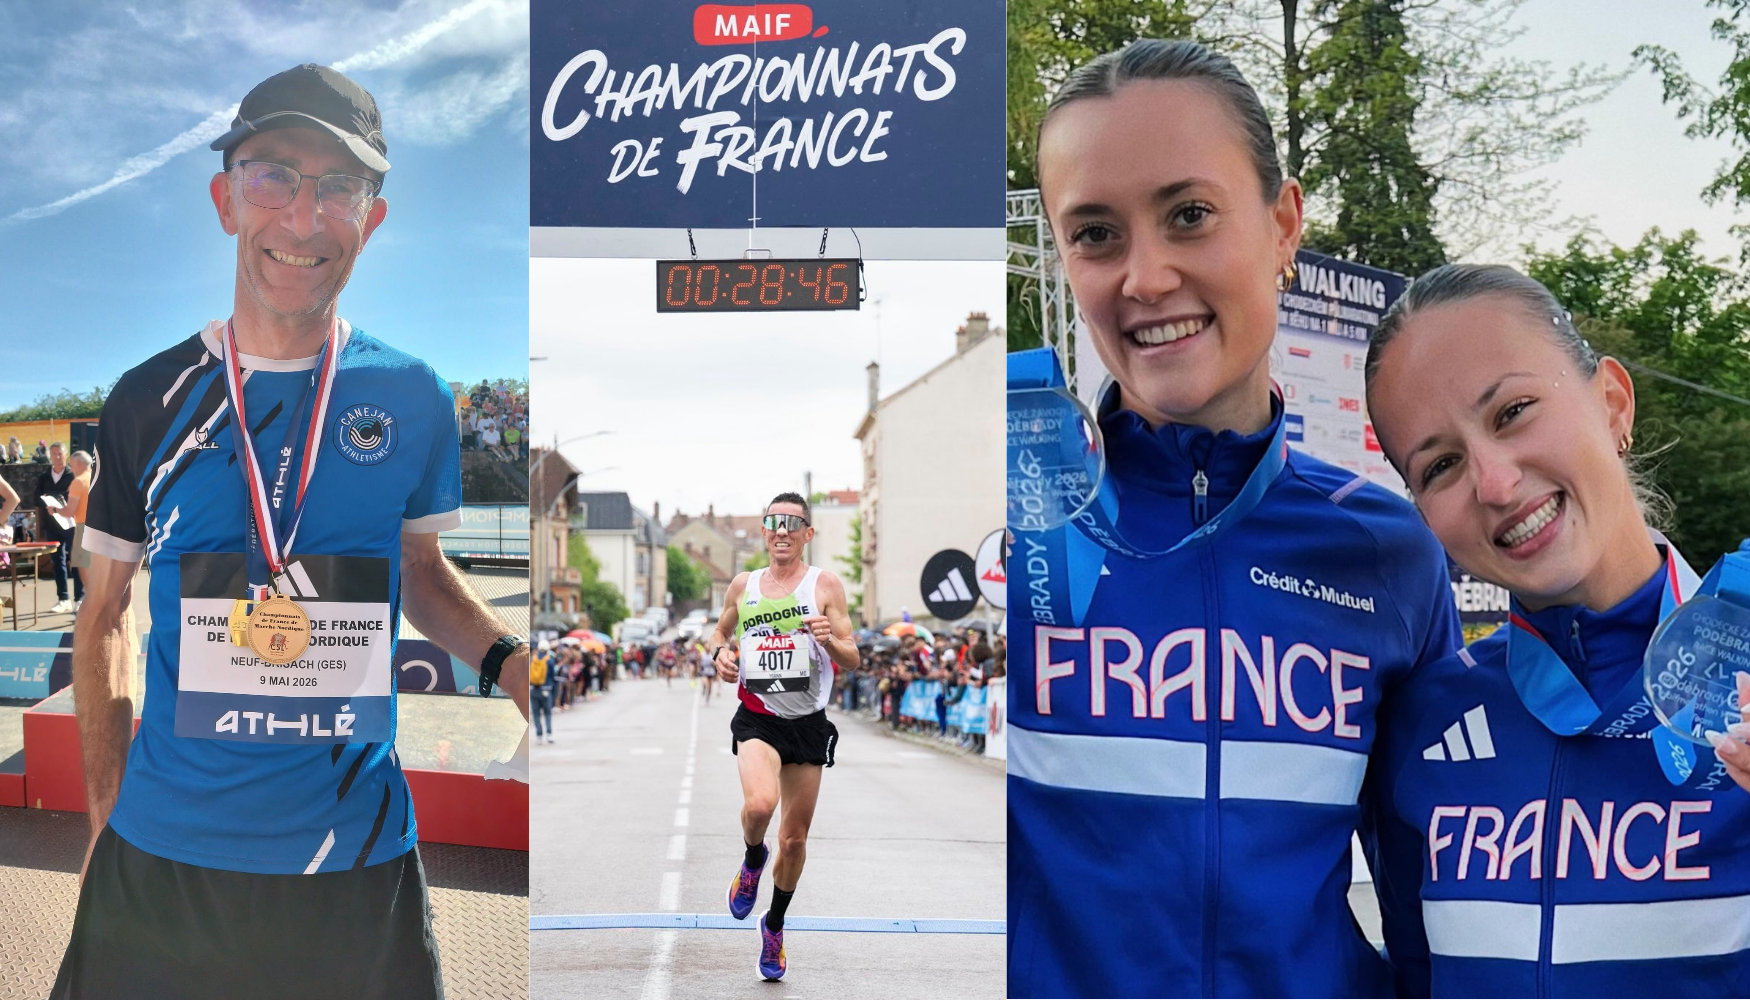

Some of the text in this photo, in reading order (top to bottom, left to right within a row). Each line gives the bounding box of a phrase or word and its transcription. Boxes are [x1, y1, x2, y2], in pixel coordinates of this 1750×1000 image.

[714, 13, 791, 37] MAIF
[541, 27, 966, 141] CHAMPIONNATS
[607, 110, 894, 195] DE FRANCE
[665, 263, 849, 307] 00:28:46
[1298, 262, 1386, 309] WALKING
[340, 407, 393, 427] CANEJAN
[1250, 566, 1375, 613] Crédit Mutuel
[311, 620, 327, 631] DE
[331, 620, 384, 631] FRANCE
[743, 605, 810, 632] DORDOGNE
[207, 632, 369, 647] DE ORDIQUE
[761, 638, 793, 649] MAIF
[317, 660, 347, 671] (GES)
[758, 650, 793, 671] 4017
[260, 675, 318, 687] 9 MAI 2026
[1035, 624, 1370, 738] FRANCE
[216, 703, 356, 737] ATHLÉ
[1428, 798, 1712, 882] FRANCE
